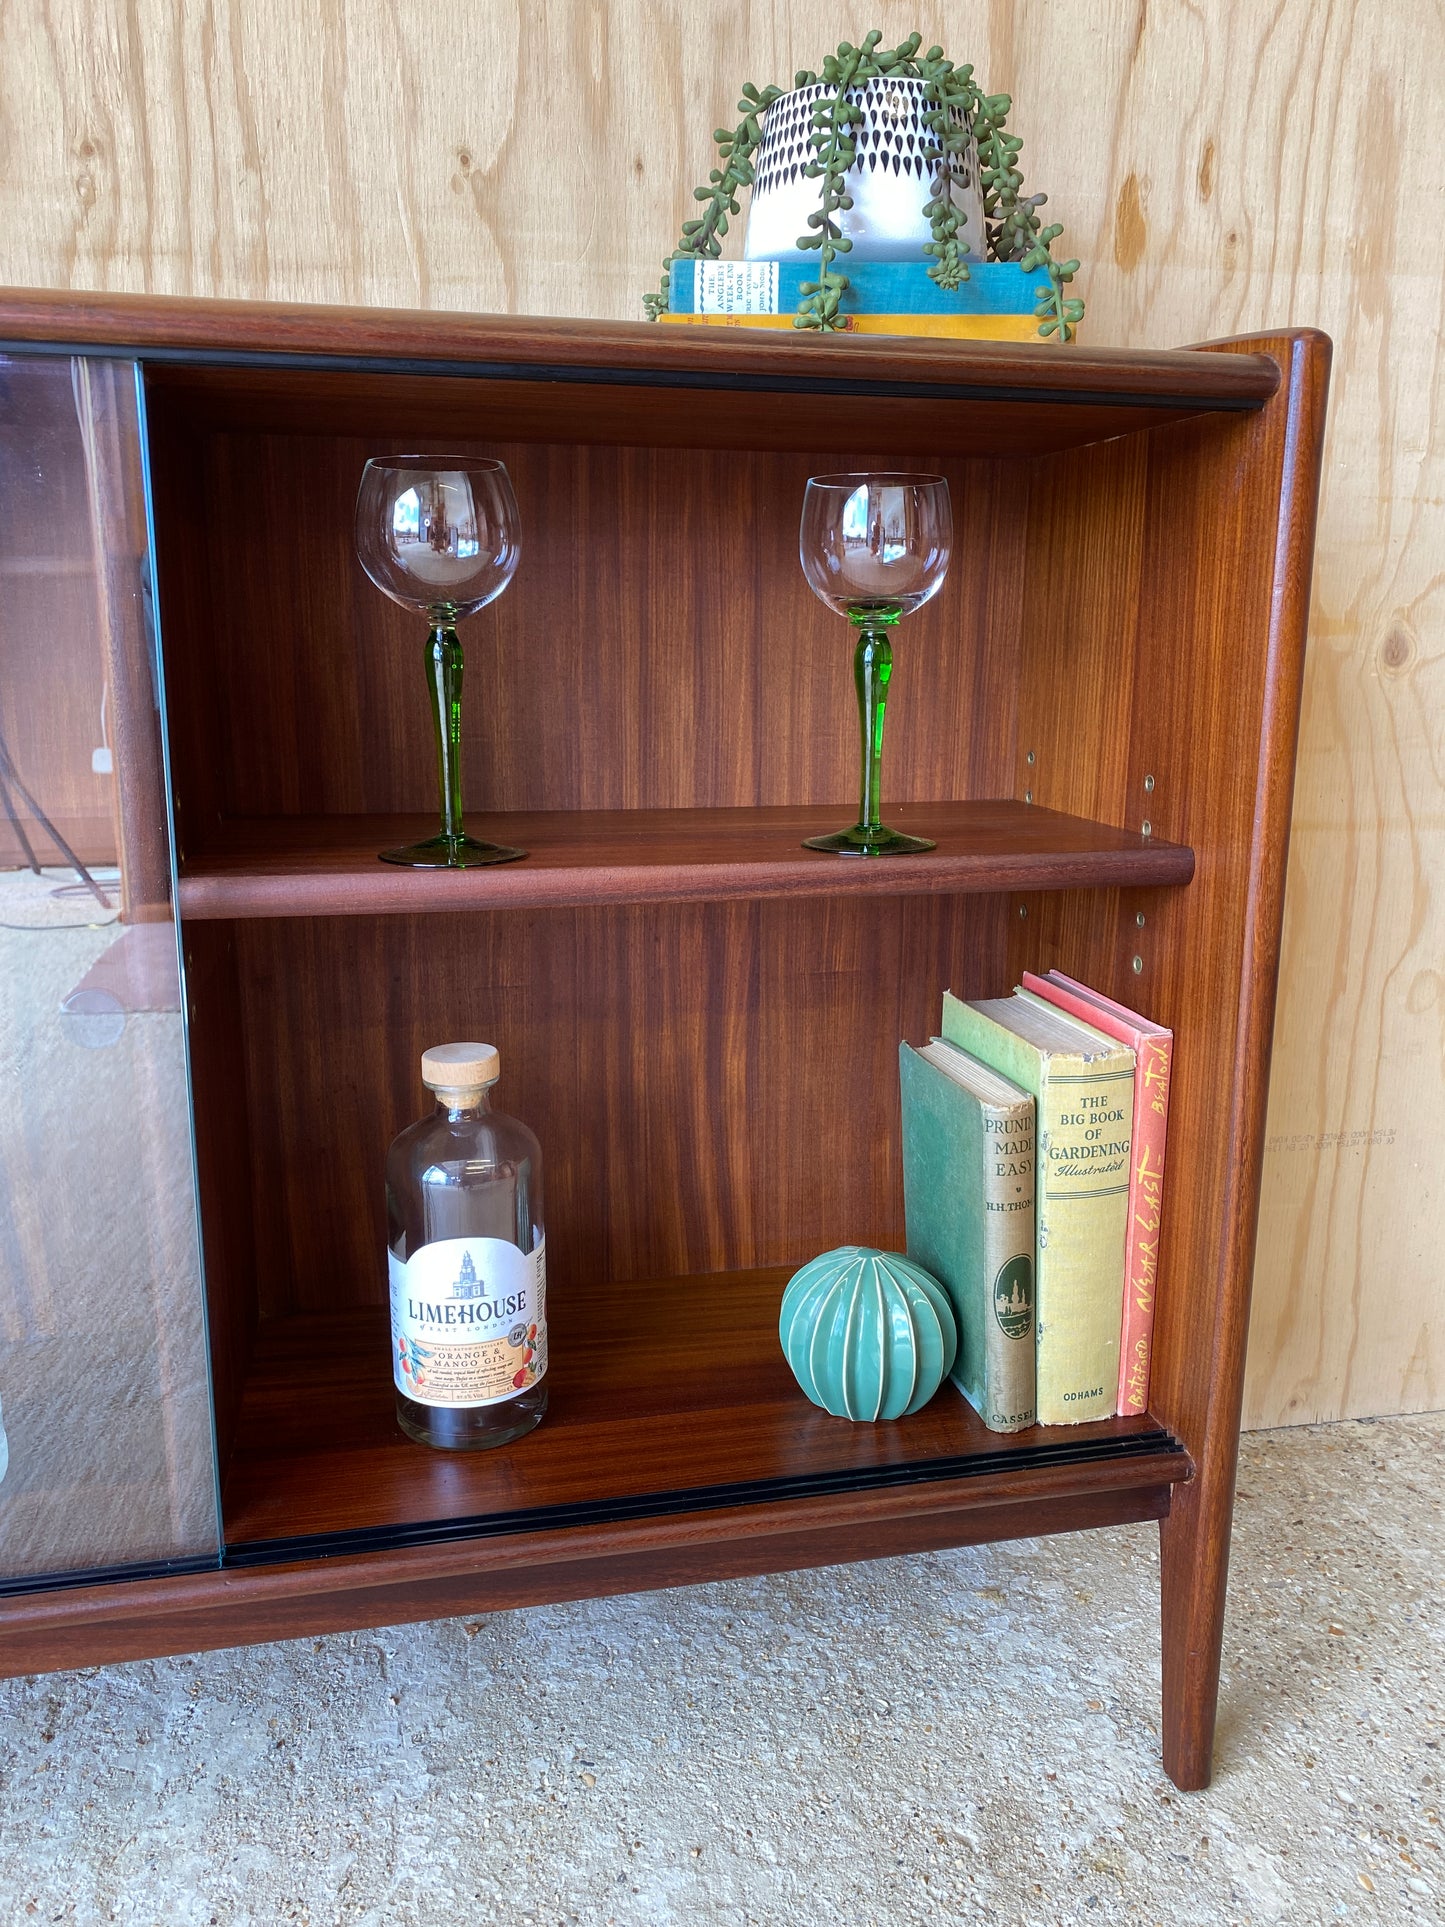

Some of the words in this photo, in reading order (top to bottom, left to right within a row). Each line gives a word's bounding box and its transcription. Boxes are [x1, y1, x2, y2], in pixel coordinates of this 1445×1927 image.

[759, 291, 767, 312] JOHN
[1080, 1095, 1108, 1109] THE
[1060, 1113, 1085, 1126] BIG
[1089, 1109, 1125, 1125] BOOK
[1084, 1128, 1102, 1141] OF
[1049, 1140, 1130, 1160] GARDENING
[996, 1158, 1033, 1177] EASY
[1054, 1158, 1125, 1177] Illustrated
[1132, 1239, 1159, 1313] NEAR
[408, 1290, 526, 1325] LIMEHOUSE
[467, 1318, 513, 1332] LONDON
[434, 1360, 478, 1368] MANGO
[484, 1354, 505, 1365] GIN
[438, 1350, 488, 1360] ORANGE
[493, 1347, 500, 1355] &
[1063, 1387, 1104, 1402] ODHAMS
